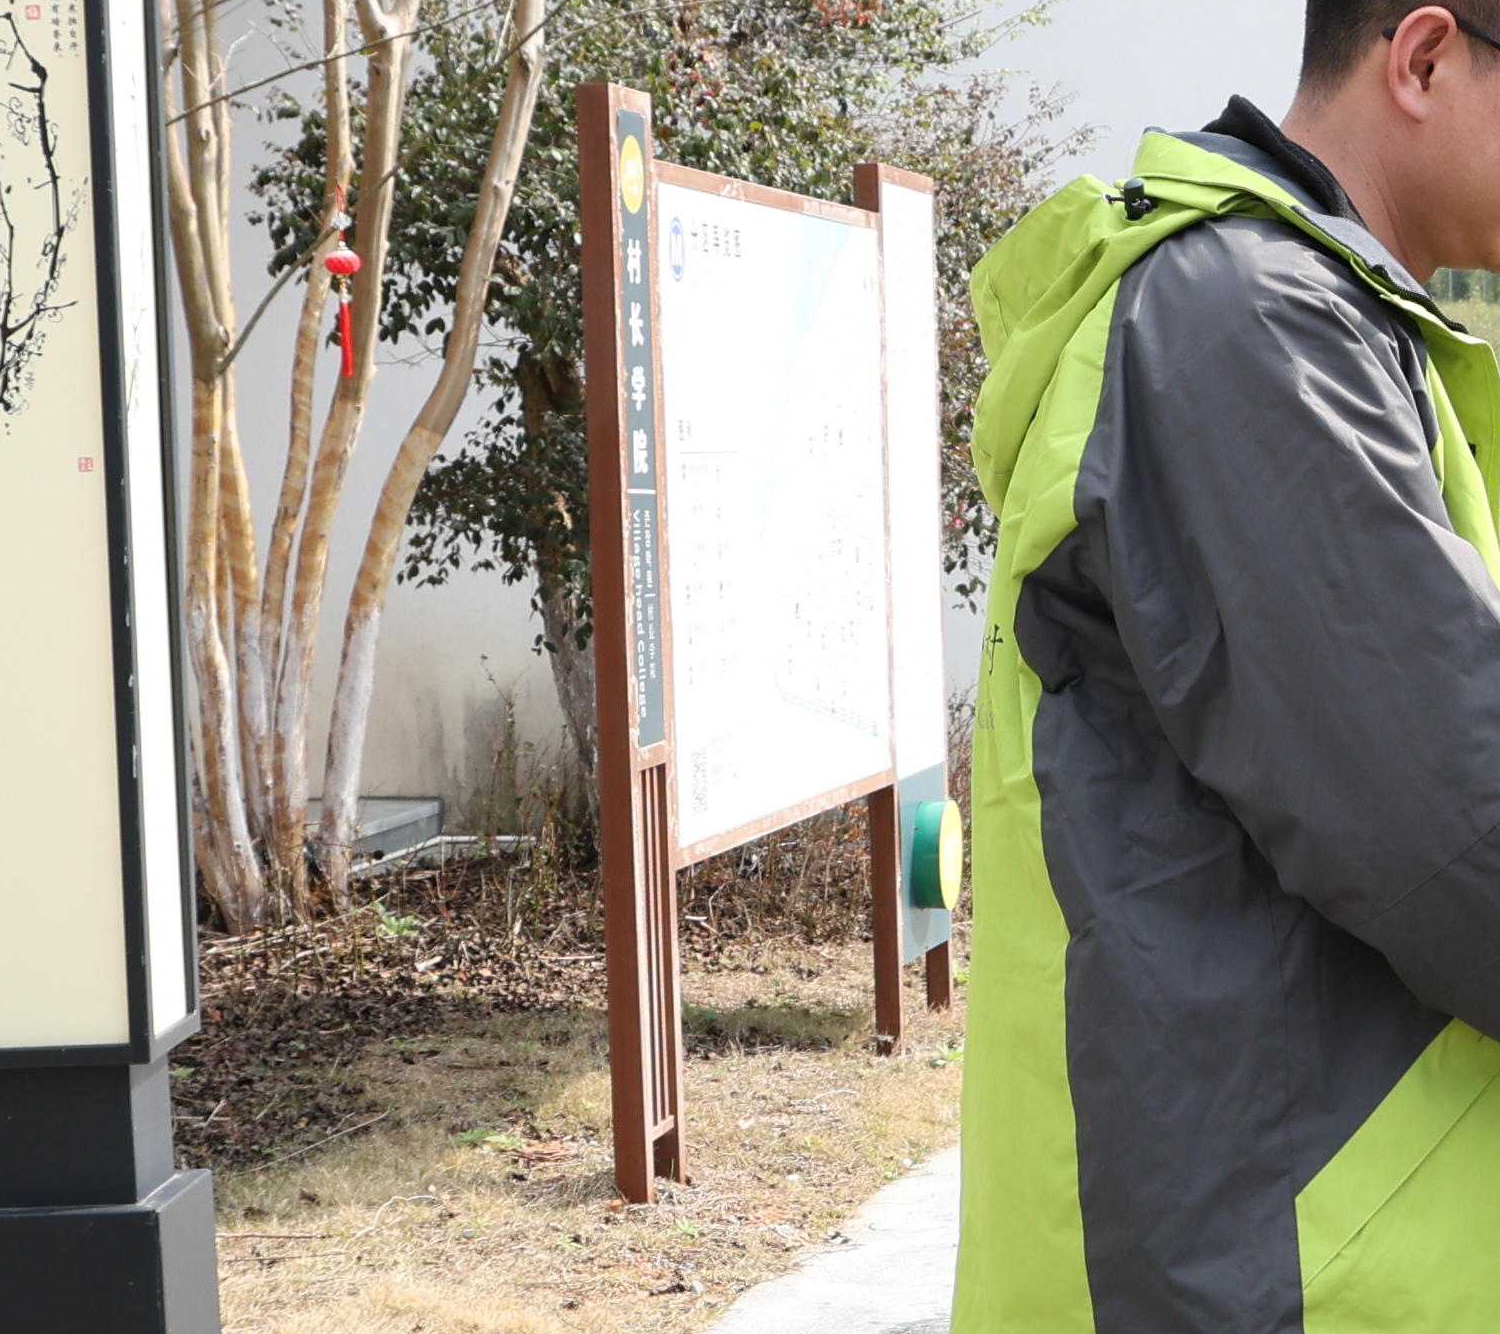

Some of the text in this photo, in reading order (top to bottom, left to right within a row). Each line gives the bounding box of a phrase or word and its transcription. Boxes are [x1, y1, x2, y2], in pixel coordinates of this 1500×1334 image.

[690, 220, 741, 258] 分区导览图
[627, 238, 648, 474] 村长学院
[632, 509, 647, 719] Village head College
